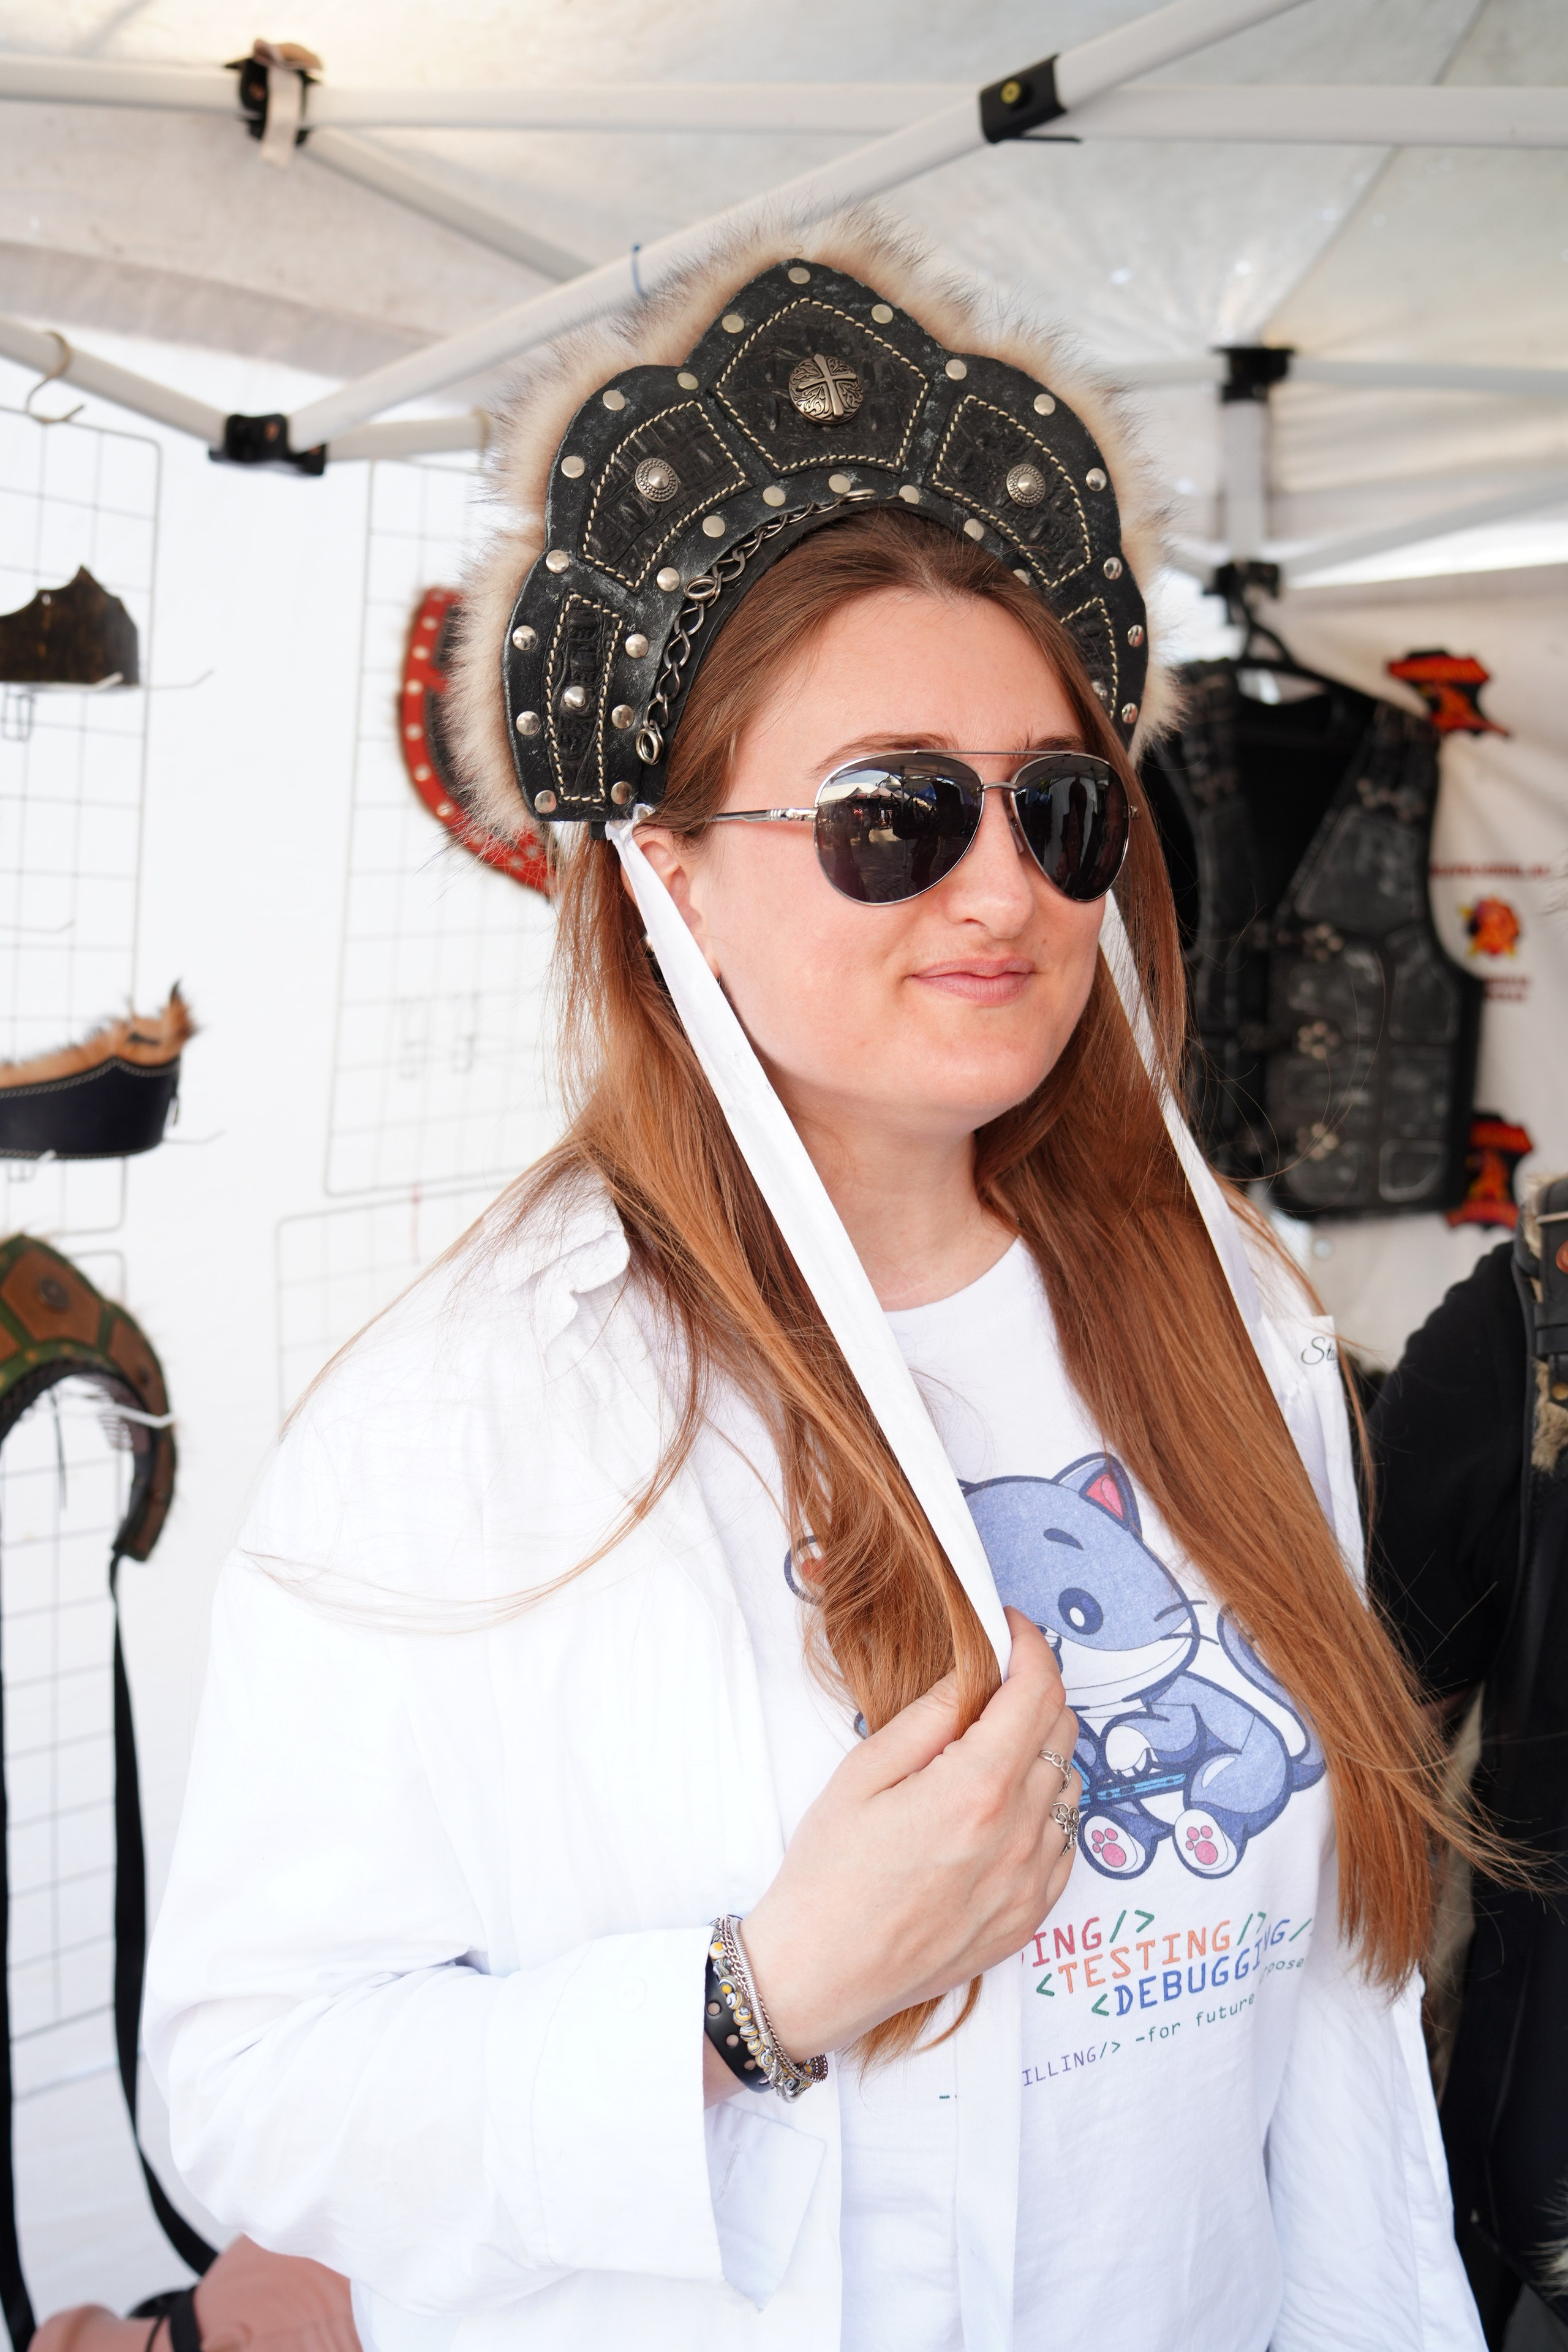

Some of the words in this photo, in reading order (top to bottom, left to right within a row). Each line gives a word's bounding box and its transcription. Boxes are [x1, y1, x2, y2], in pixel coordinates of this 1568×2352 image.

[1021, 1909, 1155, 1967] ING/>
[1036, 1911, 1267, 1997] <TESTING/>
[1196, 1992, 1254, 2026] future
